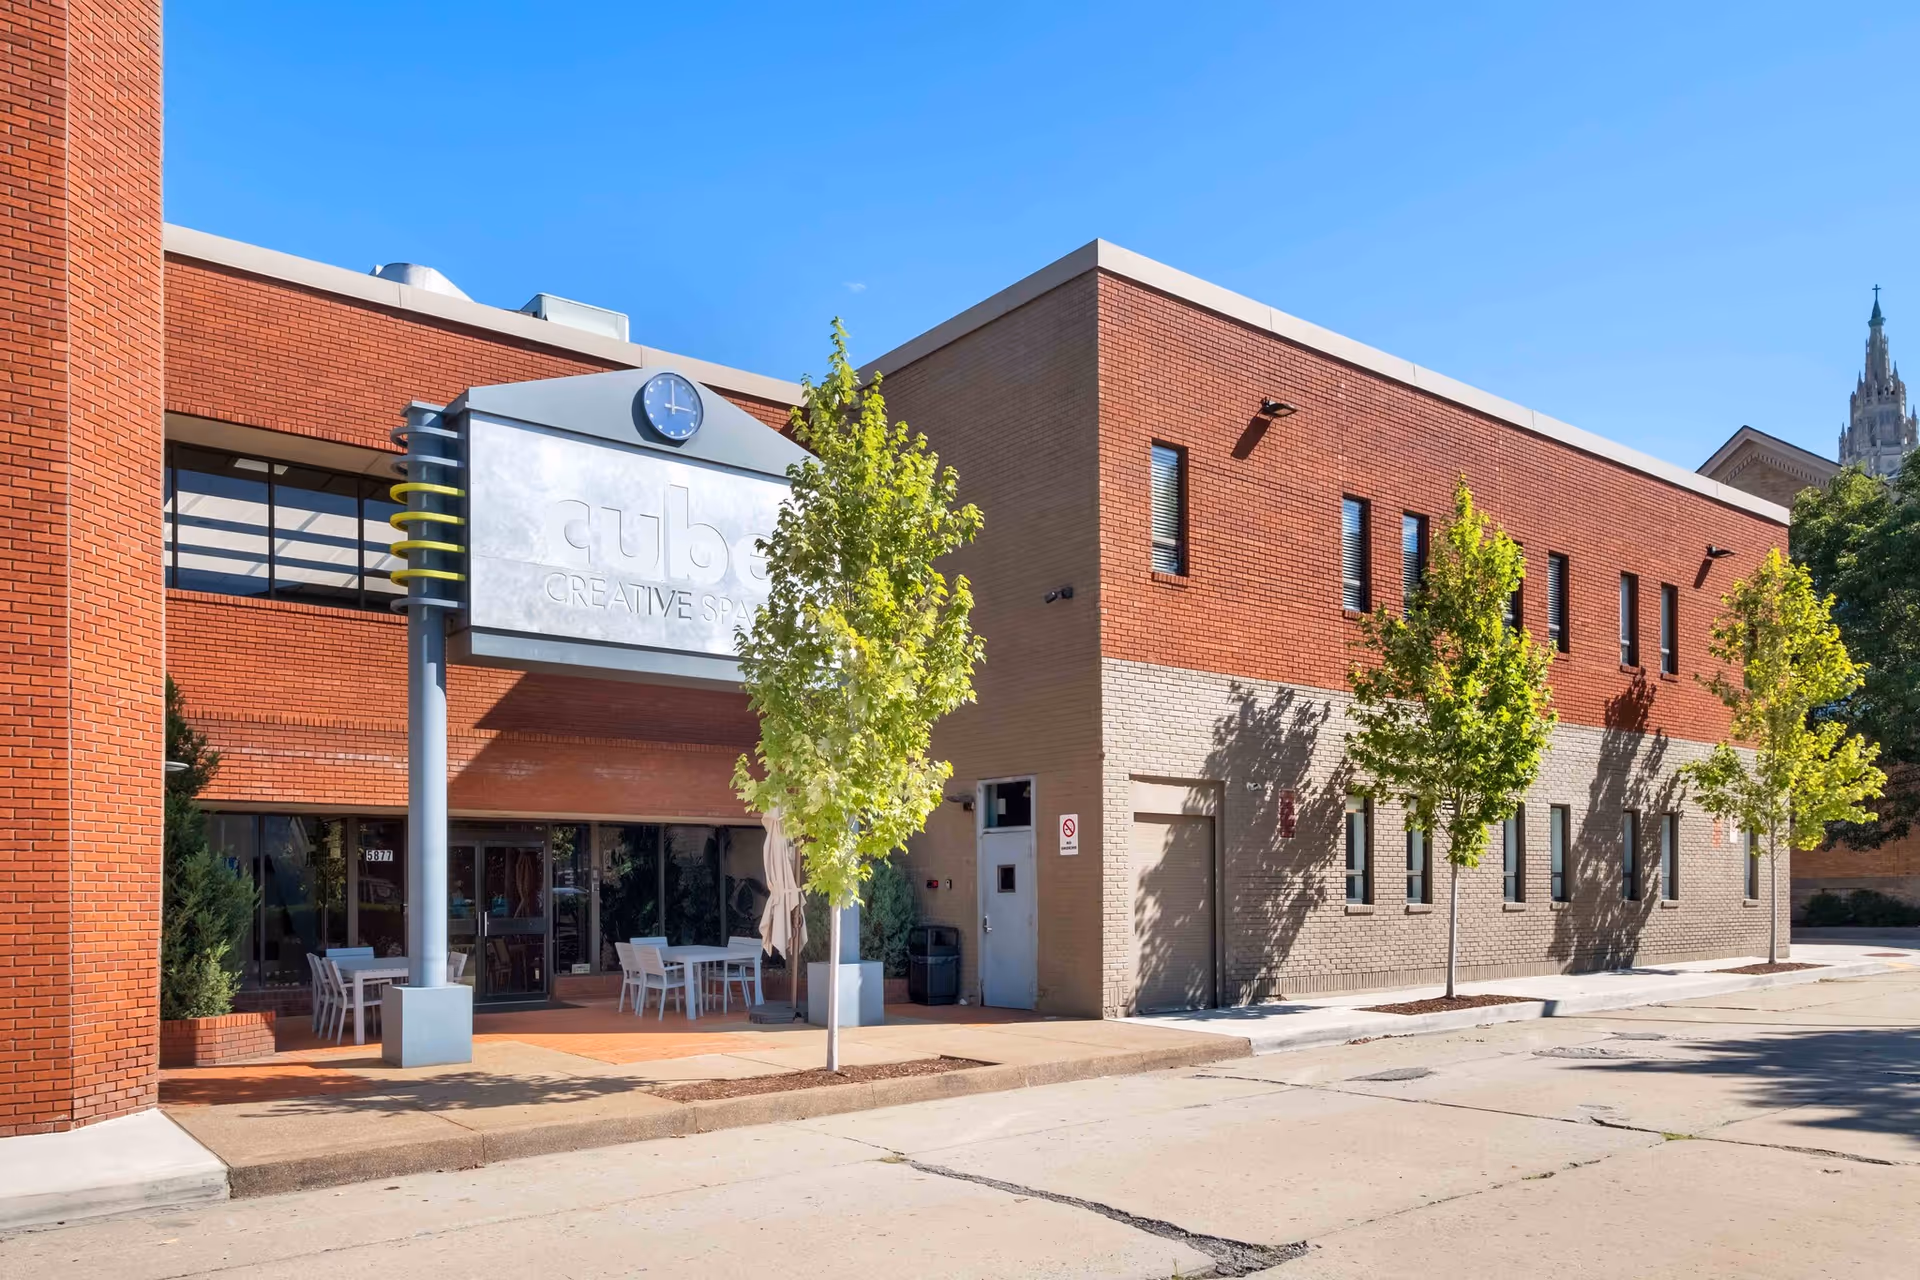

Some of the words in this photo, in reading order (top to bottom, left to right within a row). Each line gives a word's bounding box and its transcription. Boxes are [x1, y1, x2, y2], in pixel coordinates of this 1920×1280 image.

[545, 572, 692, 620] CREATIVE
[700, 593, 768, 631] SPA
[367, 850, 392, 861] 5877
